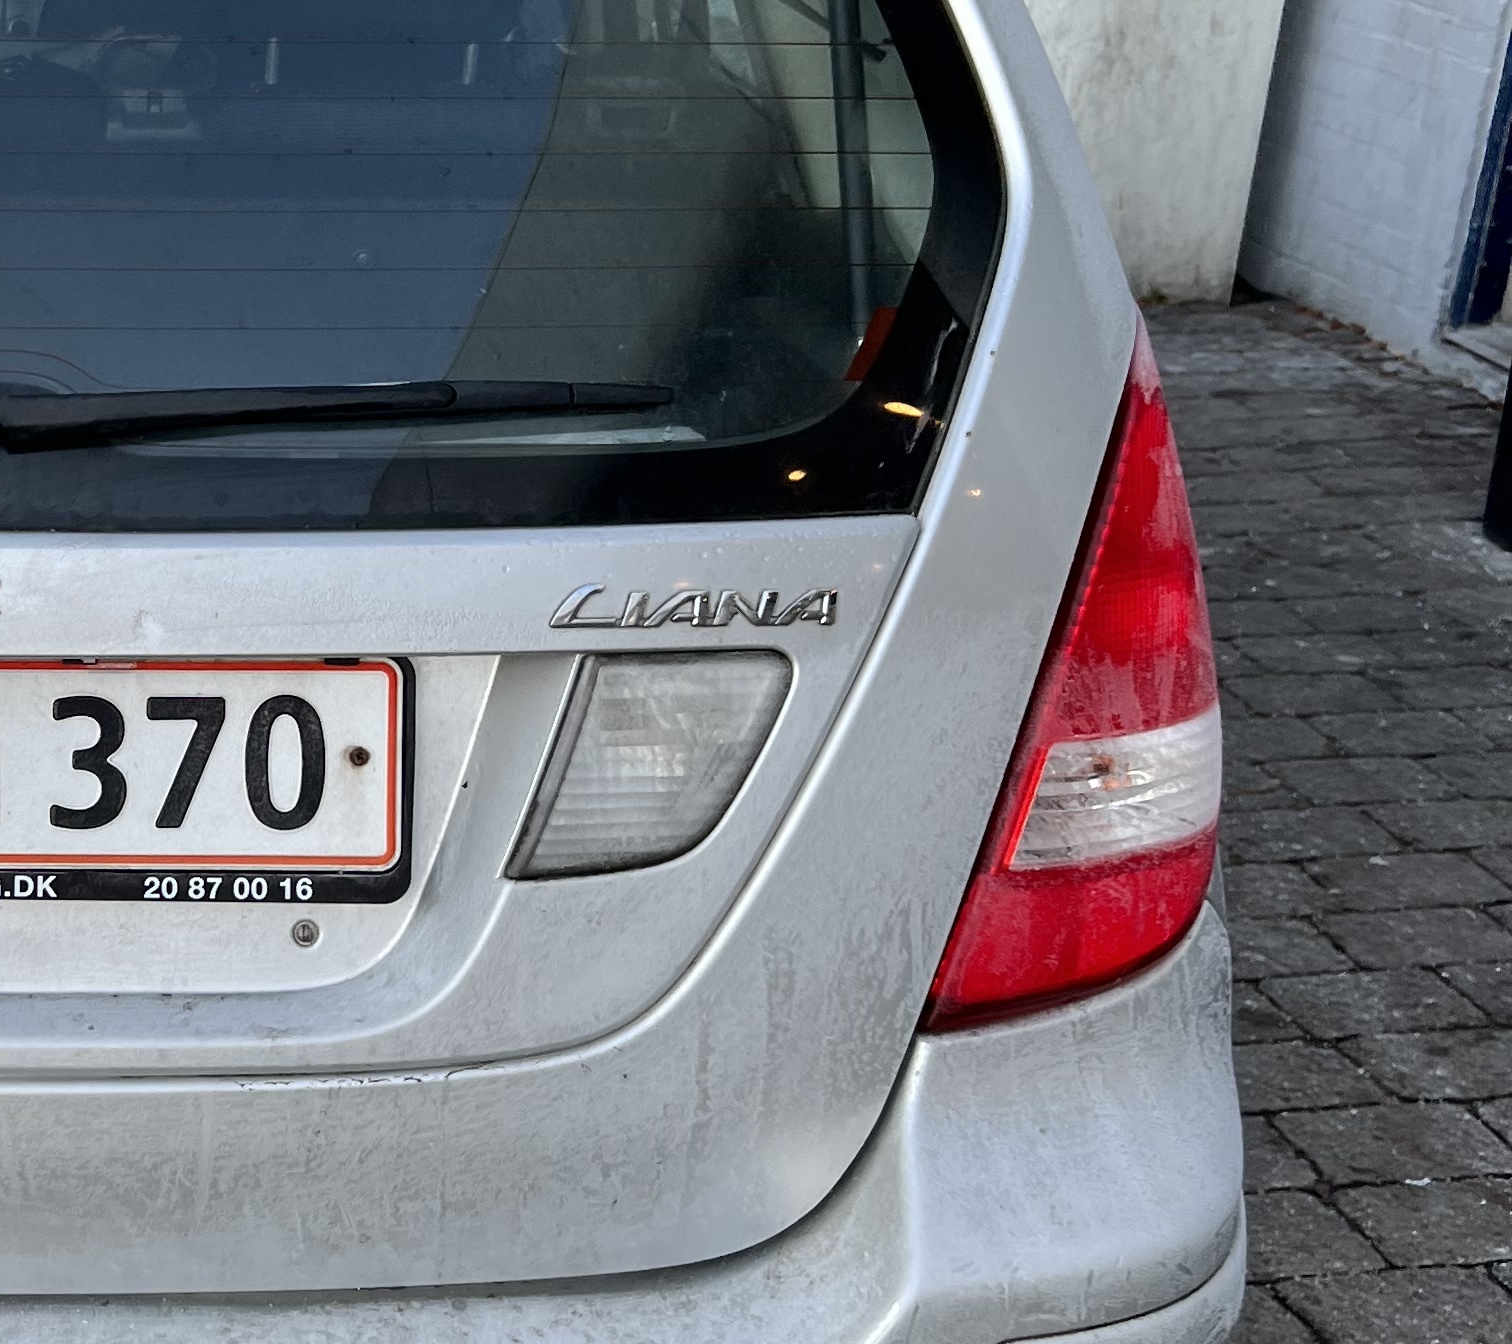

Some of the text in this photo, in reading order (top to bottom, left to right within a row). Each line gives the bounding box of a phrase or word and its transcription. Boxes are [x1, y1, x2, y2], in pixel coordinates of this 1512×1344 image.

[549, 583, 838, 629] LIANA
[49, 694, 326, 831] 370
[143, 876, 313, 900] 20 87 00 16
